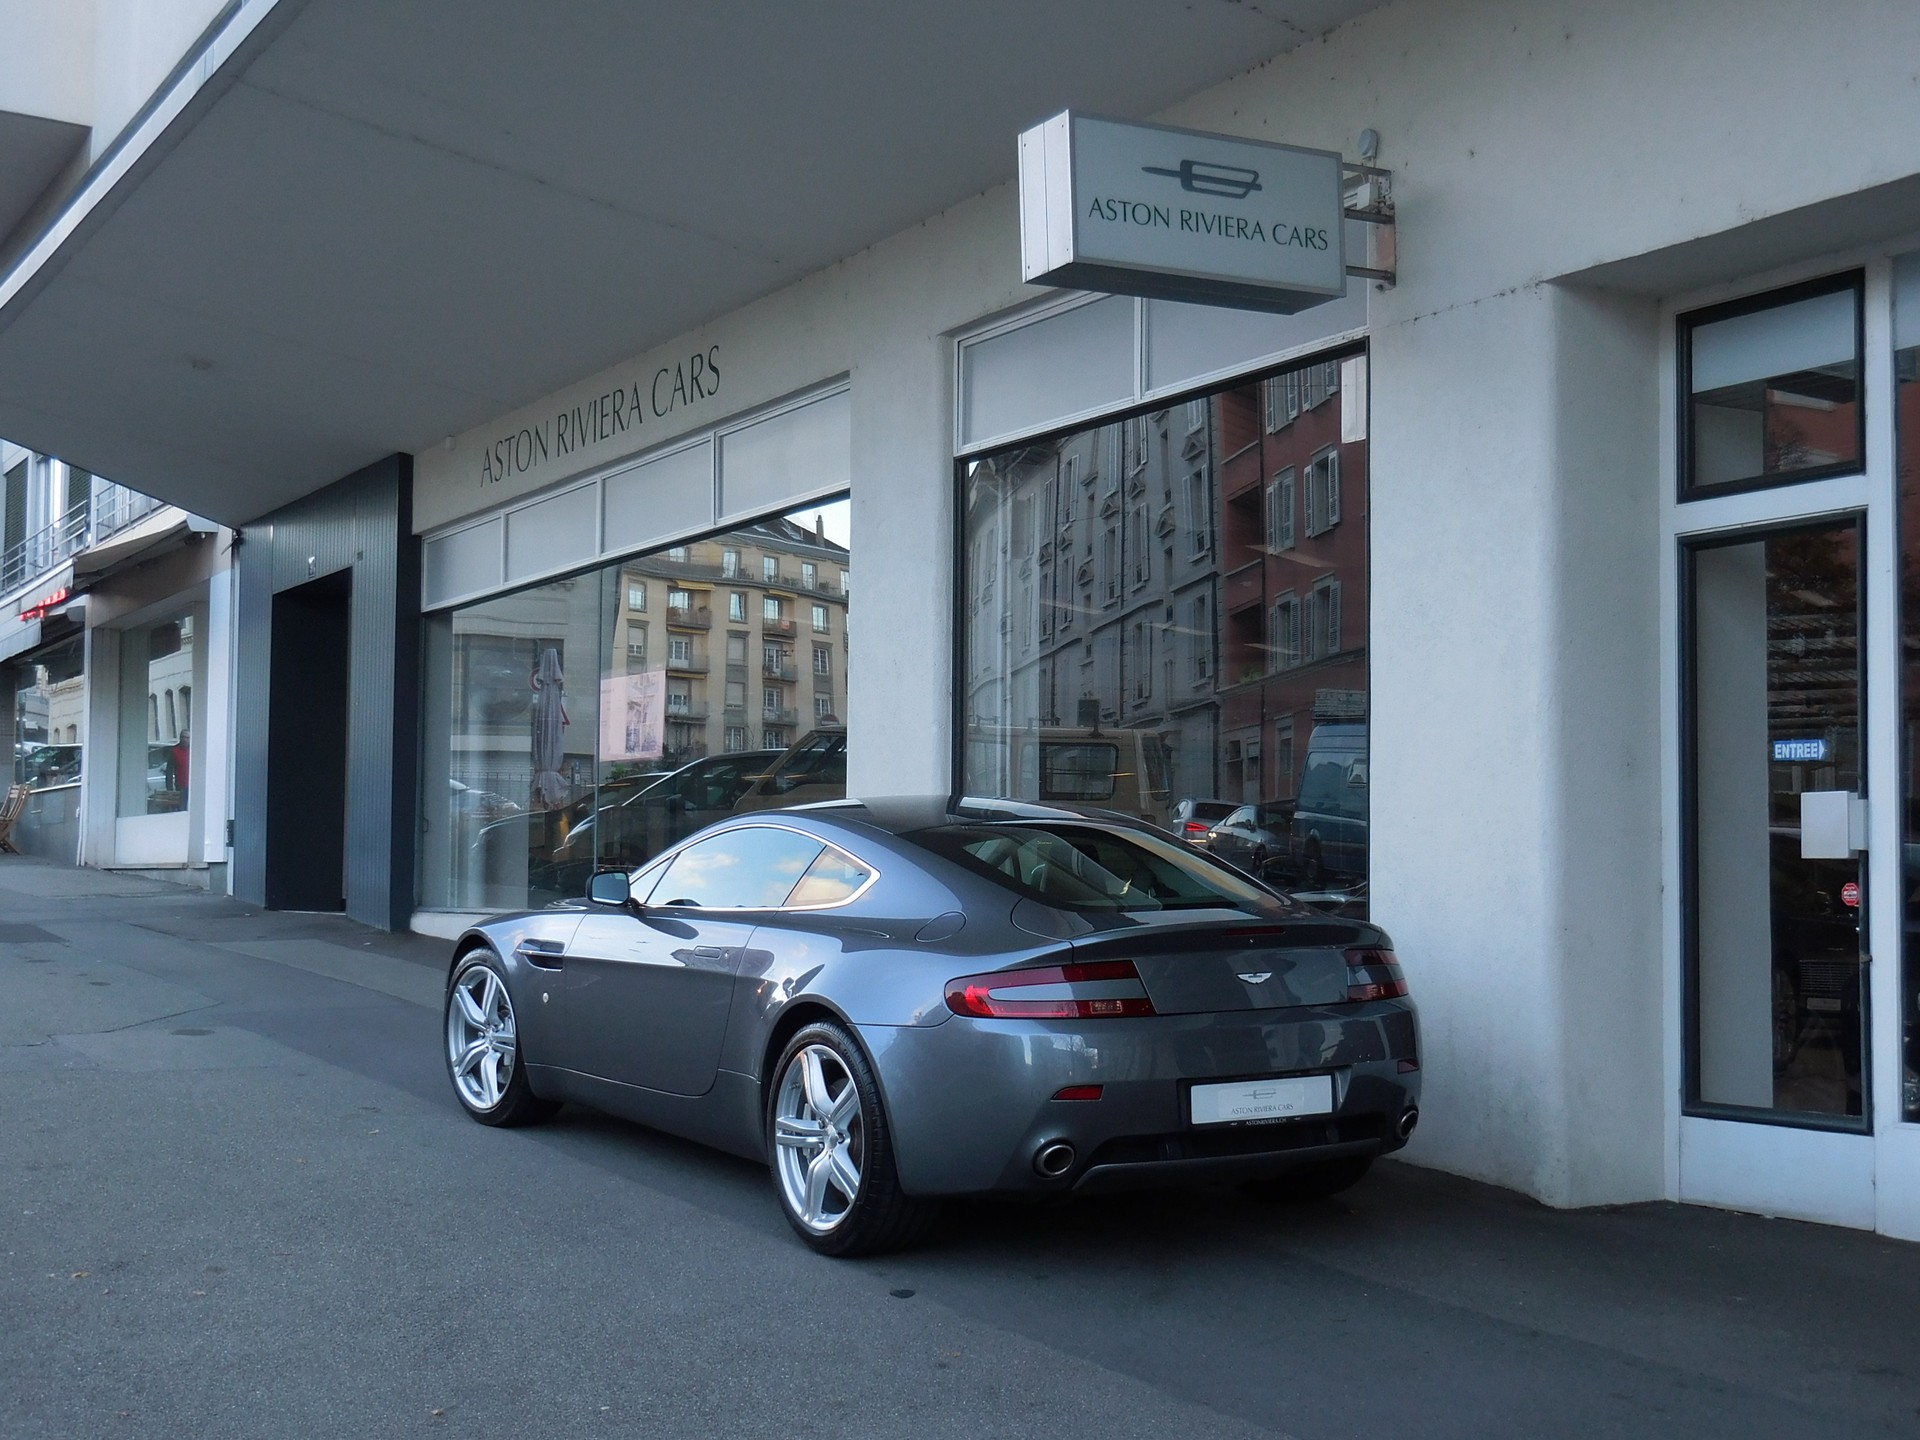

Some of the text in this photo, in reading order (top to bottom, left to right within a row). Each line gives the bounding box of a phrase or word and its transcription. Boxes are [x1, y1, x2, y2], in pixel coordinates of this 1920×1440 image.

[1089, 197, 1328, 251] ASTON RIVIERA CARS
[480, 345, 720, 488] ASTON RIVIERA CARS
[1775, 743, 1818, 759] ENTREE
[1231, 1103, 1294, 1115] ASTON RIVIERA CARS
